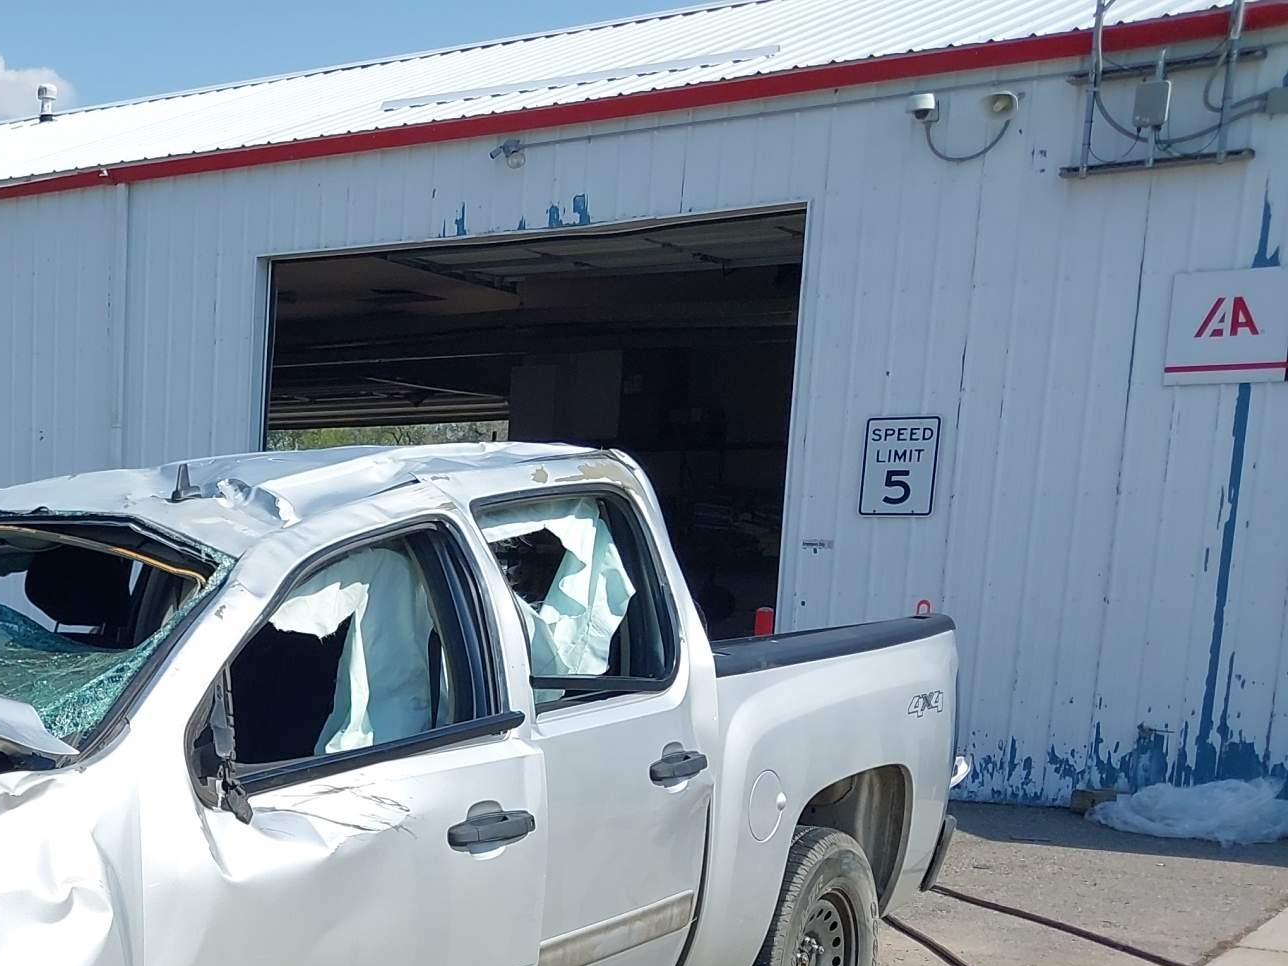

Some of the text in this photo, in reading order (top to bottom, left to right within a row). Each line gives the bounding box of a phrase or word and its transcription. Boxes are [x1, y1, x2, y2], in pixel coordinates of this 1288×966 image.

[871, 427, 934, 442] SPEED
[875, 448, 925, 463] LIMIT
[881, 469, 911, 505] 5
